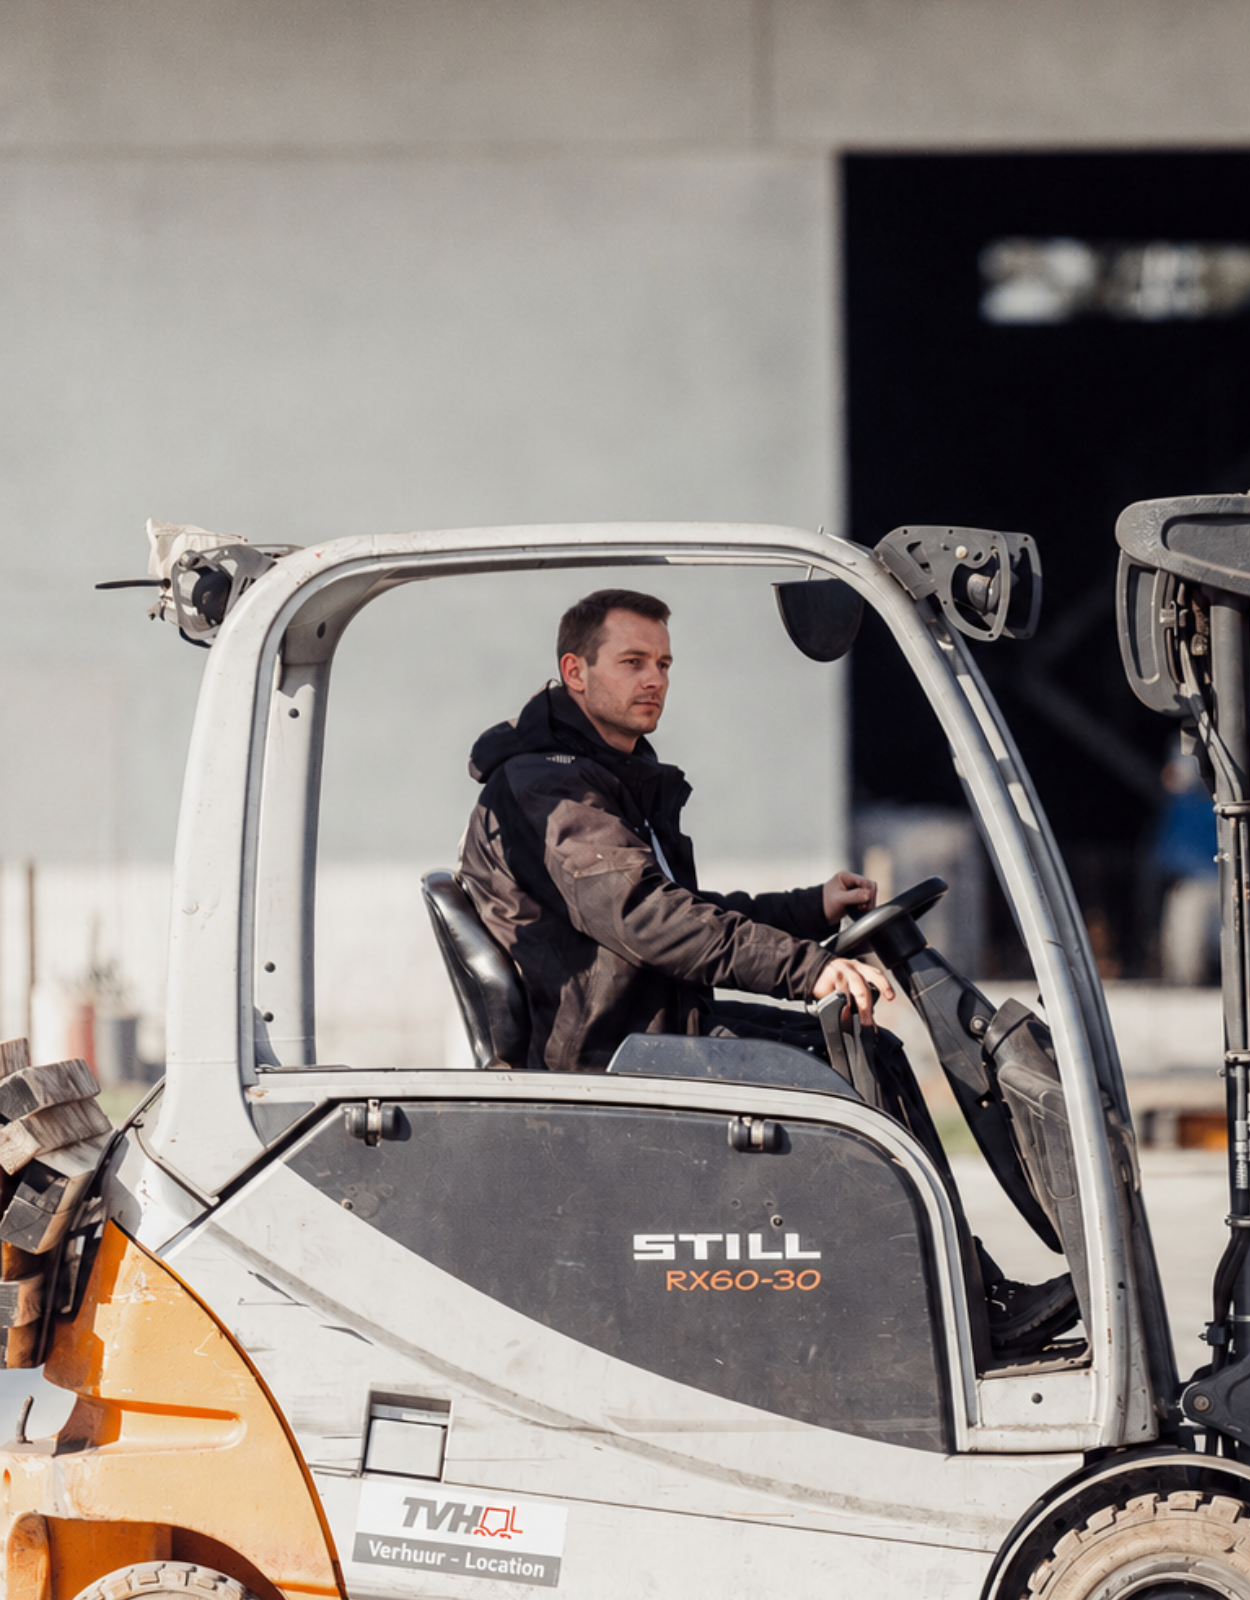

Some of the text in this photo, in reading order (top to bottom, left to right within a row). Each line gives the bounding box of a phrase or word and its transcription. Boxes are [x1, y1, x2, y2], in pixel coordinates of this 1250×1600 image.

[633, 1233, 821, 1260] STILL
[666, 1269, 821, 1291] RX60-30
[402, 1497, 483, 1534] TVH
[368, 1540, 446, 1566] Verhuur
[465, 1552, 545, 1578] Location
